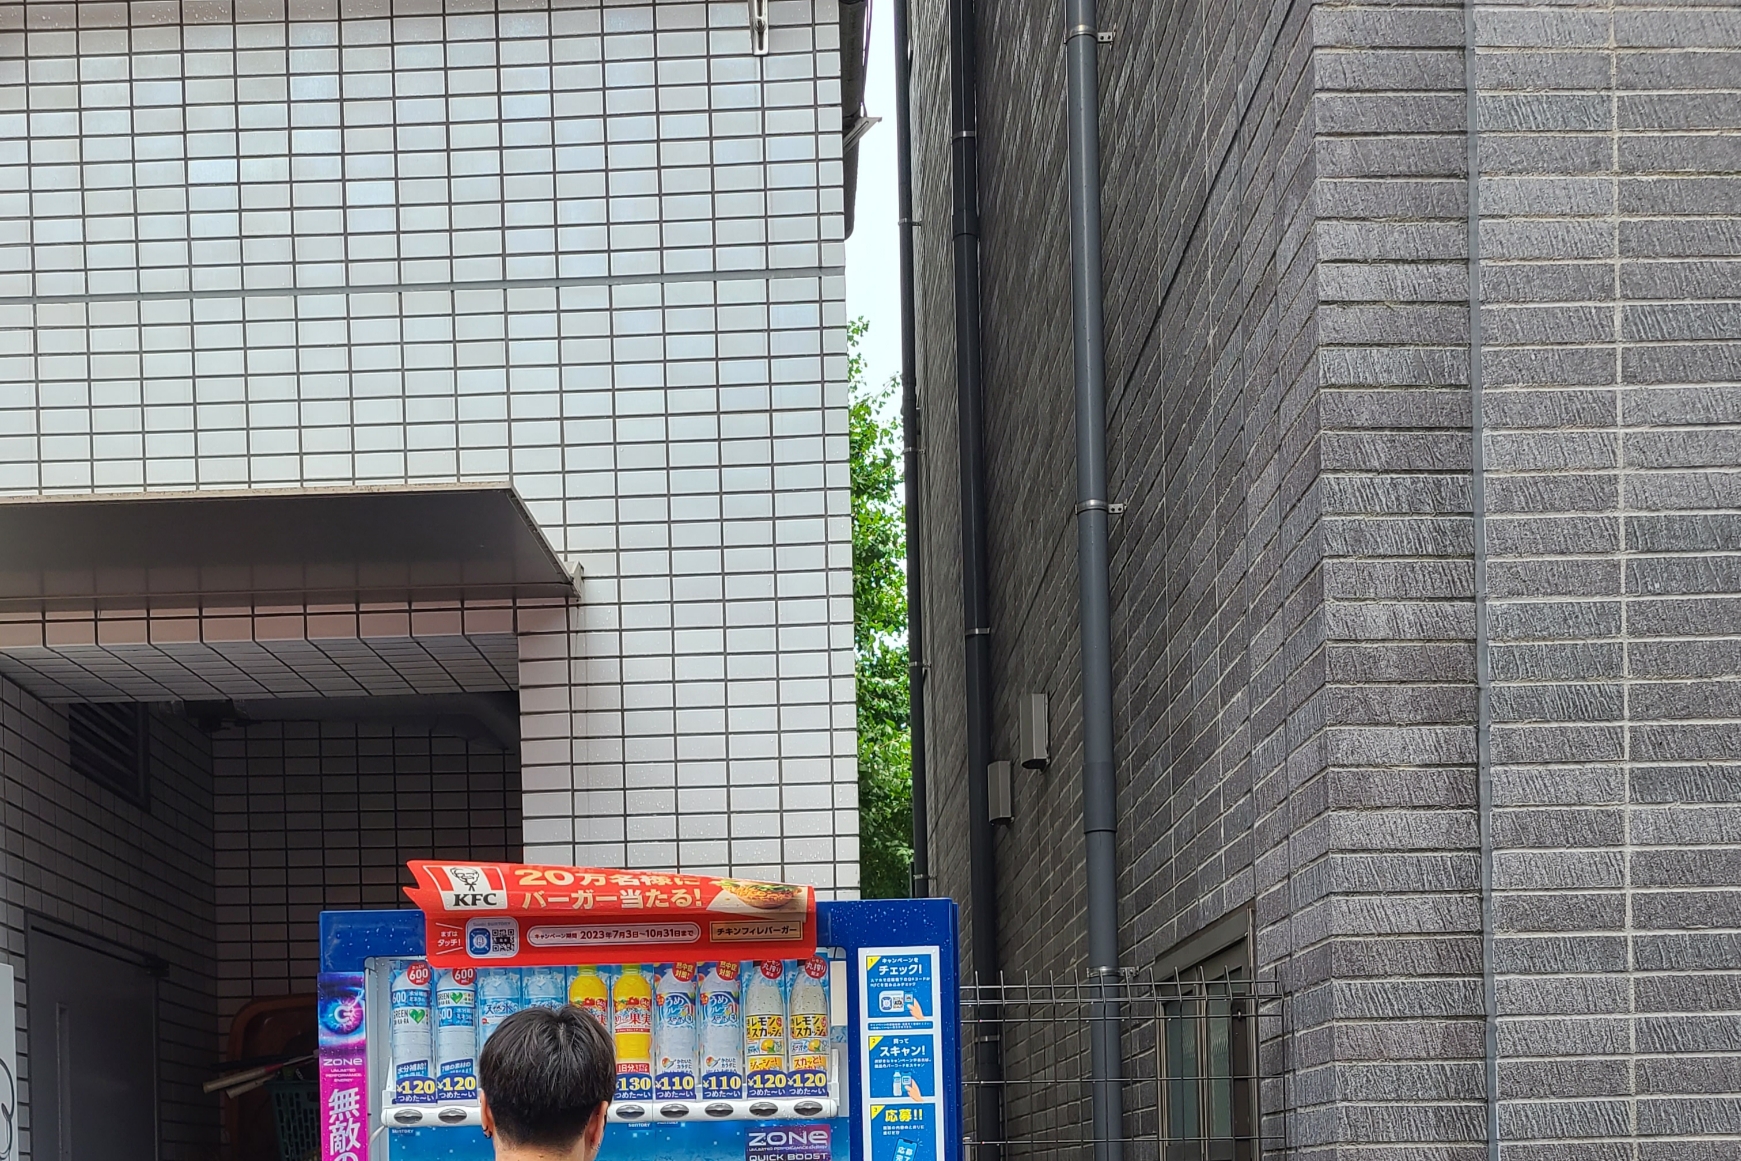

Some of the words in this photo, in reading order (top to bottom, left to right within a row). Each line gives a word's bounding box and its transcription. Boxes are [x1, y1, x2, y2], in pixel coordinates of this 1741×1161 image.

[514, 868, 700, 887] 20万名様に
[453, 892, 497, 907] KFC
[522, 889, 702, 909] バーガー当たる!
[717, 926, 797, 936] チキンフィレバーガー
[437, 939, 461, 948] タッチ!
[409, 968, 429, 980] 600
[454, 968, 474, 979] 600
[879, 964, 922, 975] チェック!
[751, 1016, 775, 1026] レモン
[796, 1016, 820, 1026] レモン
[752, 1027, 782, 1037] スカッシュ
[796, 1026, 827, 1037] スカッシュ
[880, 1045, 925, 1057] スキャン!
[437, 1077, 476, 1091] ¥120
[655, 1076, 694, 1090] ¥110
[703, 1076, 742, 1090] ¥110
[748, 1074, 786, 1088] ¥120
[788, 1073, 826, 1087] ¥120
[397, 1080, 435, 1094] ¥120
[885, 1109, 923, 1122] 応募!!
[787, 1152, 828, 1161] BOOST
